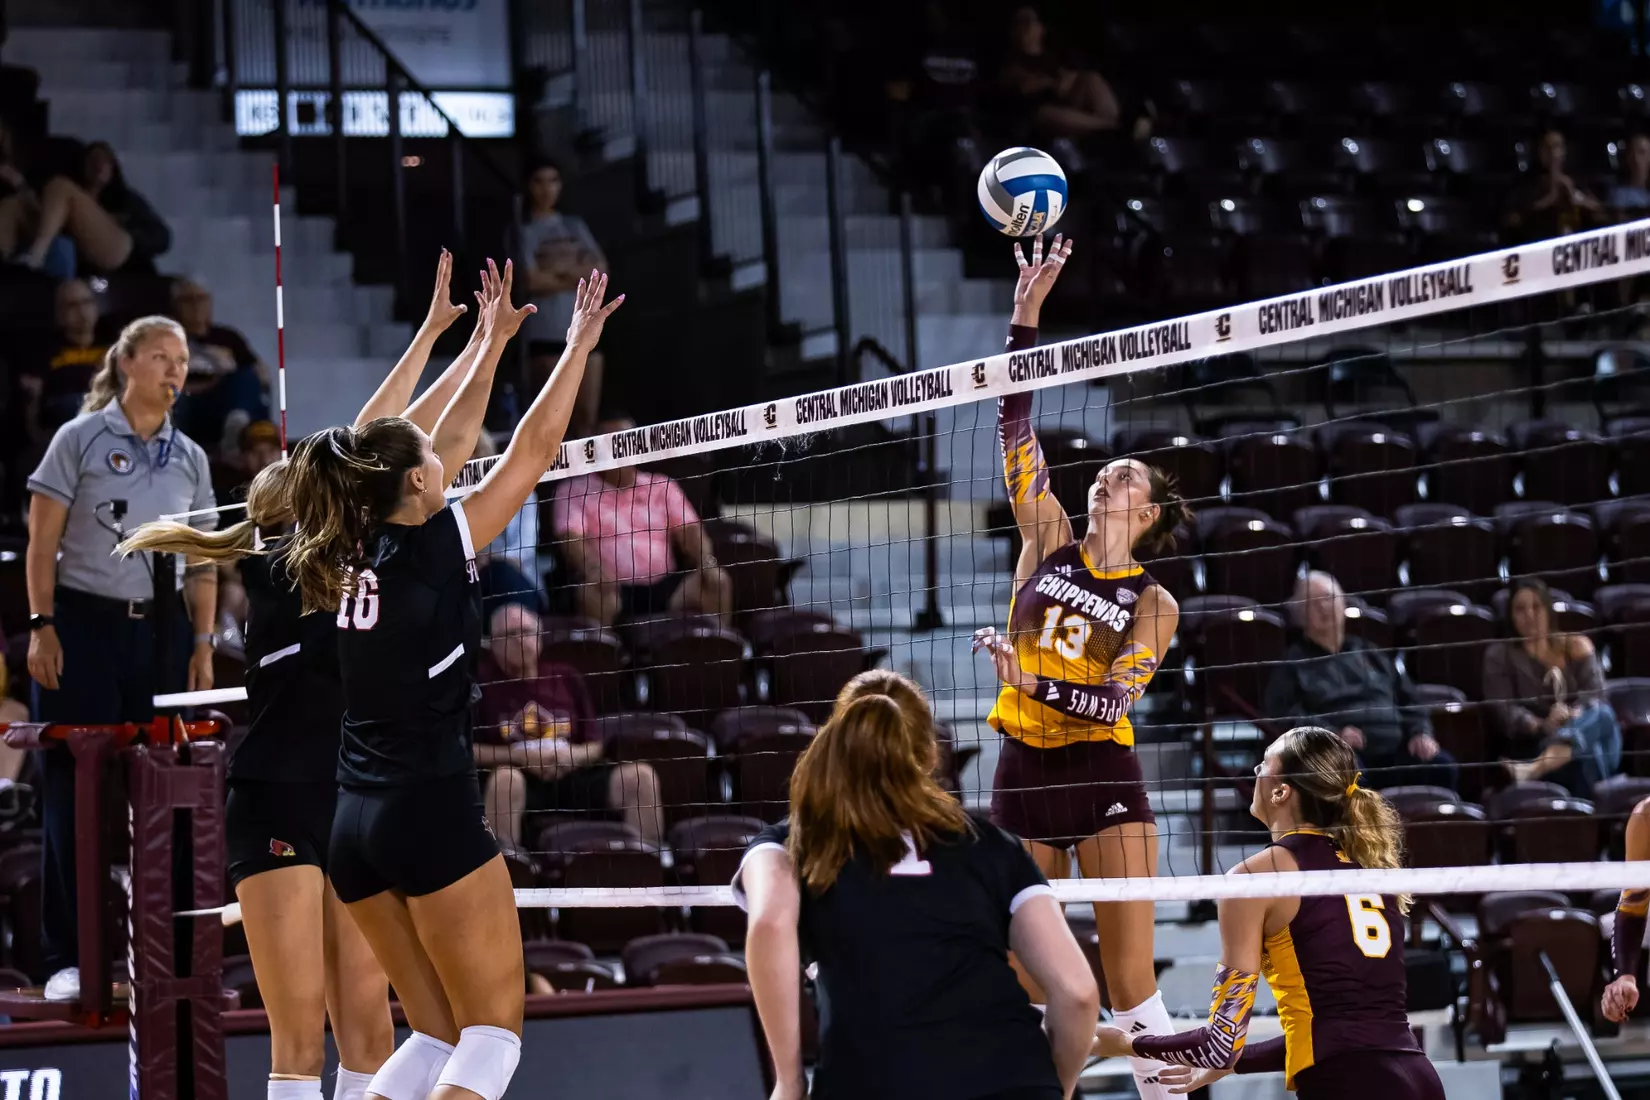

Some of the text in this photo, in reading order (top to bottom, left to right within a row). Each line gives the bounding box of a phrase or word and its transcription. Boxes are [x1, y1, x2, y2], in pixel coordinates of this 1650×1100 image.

[1552, 234, 1619, 275] CENTRAL
[1258, 264, 1473, 335] CENTRAL MICHIGAN VOLLEYBALL
[1008, 321, 1191, 383] CENTRAL MICHIGAN VOLLEYBALL
[796, 369, 953, 424] CENTRAL MICHIGAN VOLLEYBALL
[612, 409, 748, 459] CENTRAL MICHIGAN VOLLEYBALL
[336, 565, 380, 630] 16
[1035, 574, 1131, 633] CHIPPEWAS
[1036, 604, 1093, 660] 13
[1343, 893, 1392, 958] 6
